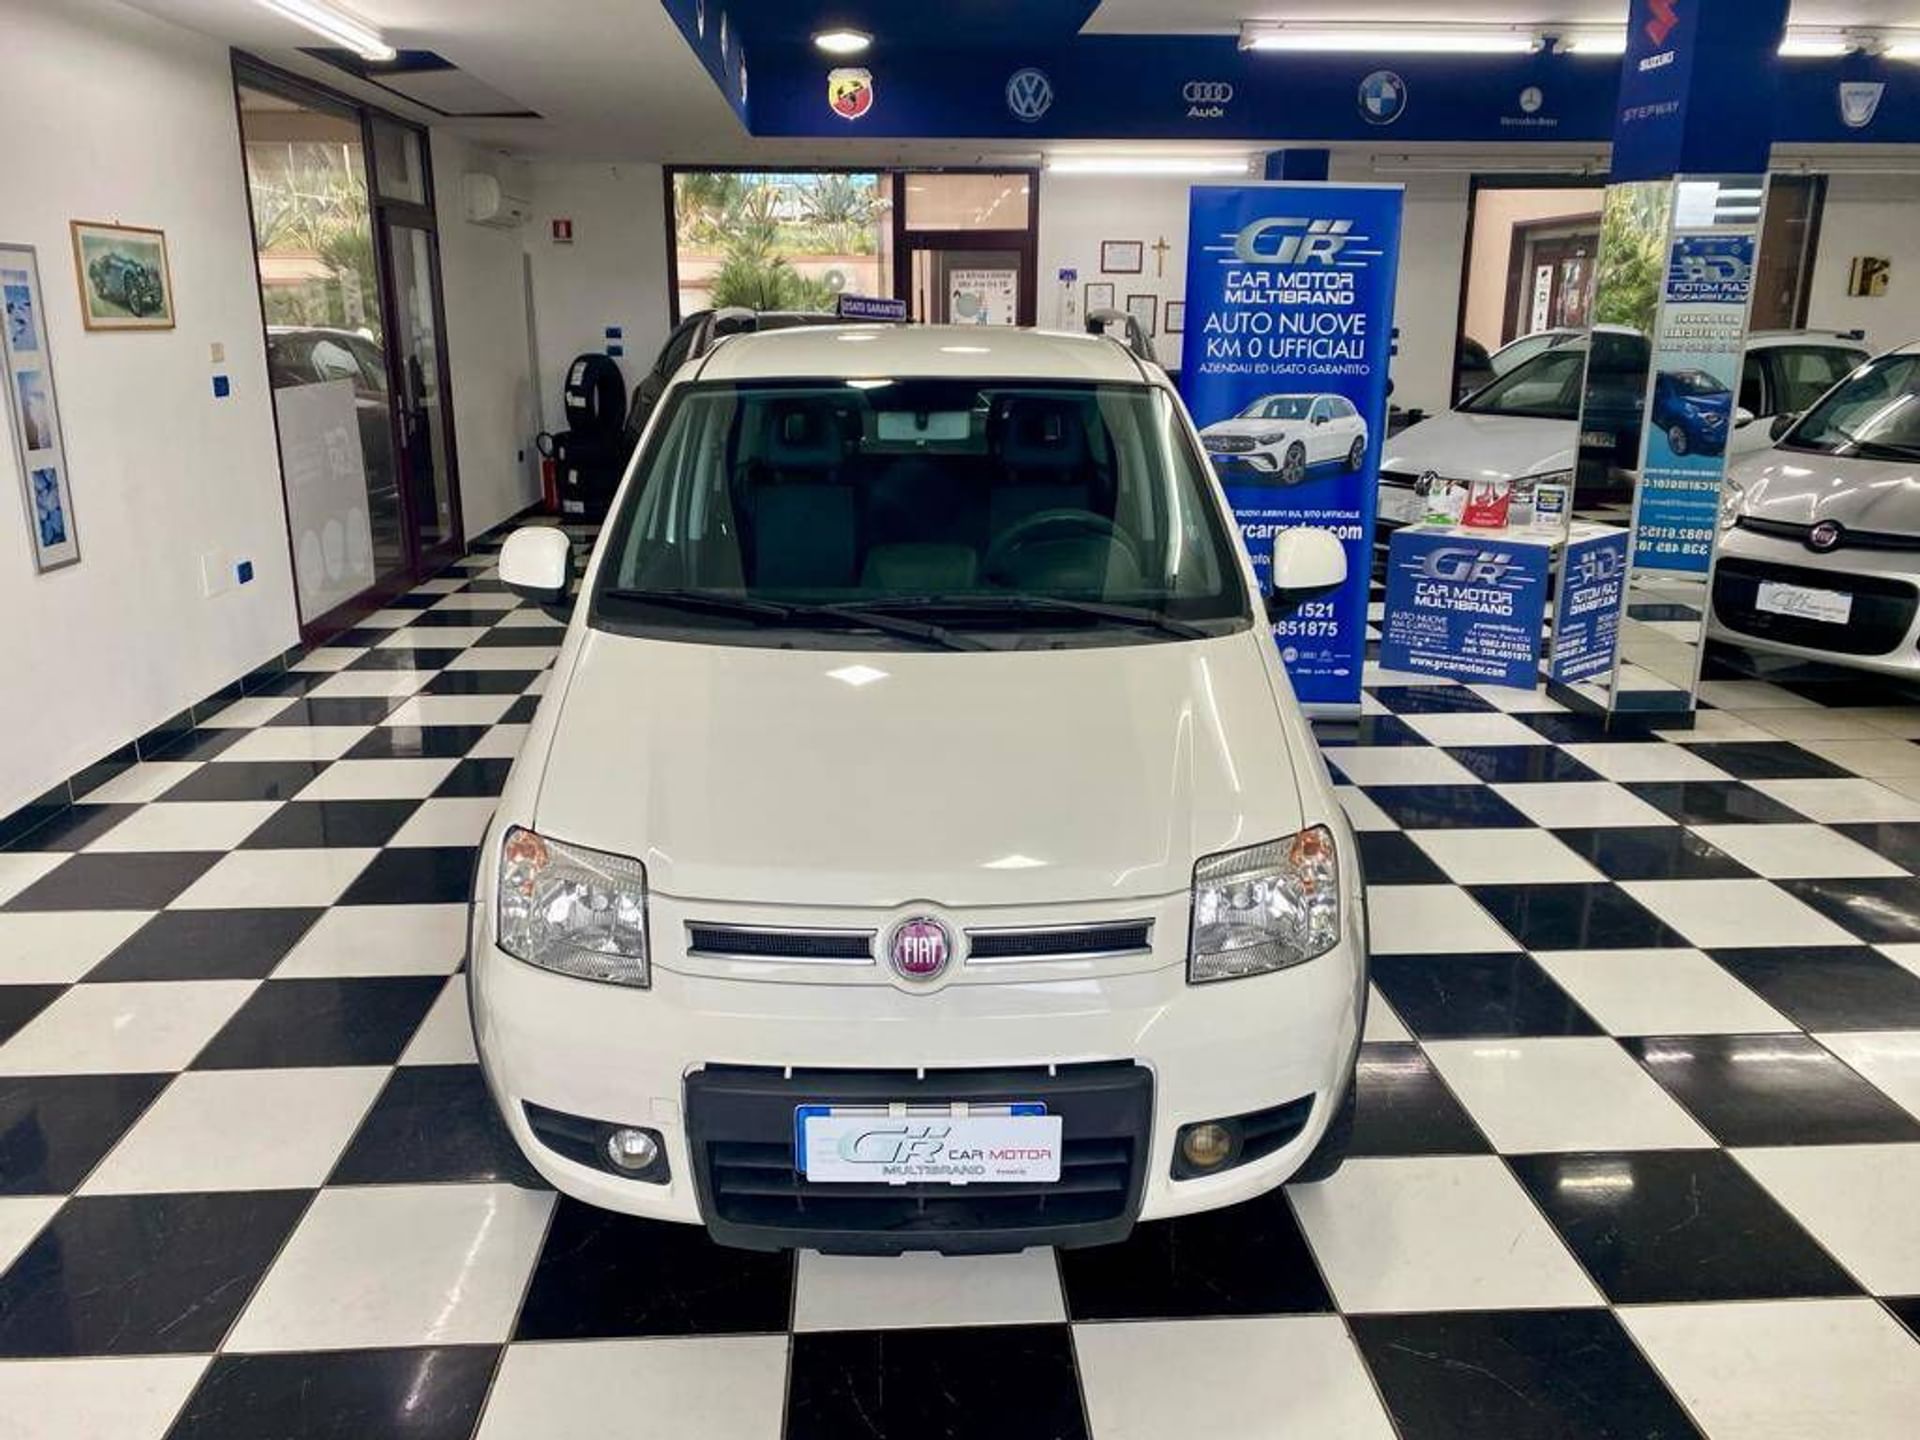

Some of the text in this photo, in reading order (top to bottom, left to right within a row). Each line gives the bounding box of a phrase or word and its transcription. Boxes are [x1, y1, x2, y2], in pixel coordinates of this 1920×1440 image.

[1187, 105, 1224, 118] Audi
[1623, 101, 1679, 122] STEPWAY
[1227, 271, 1354, 290] CAR MOTOR
[1224, 289, 1355, 305] MULTIBRAND
[1203, 312, 1366, 335] AUTO NUOVE
[1207, 338, 1365, 360] KM 0 UFFICIALI
[1199, 364, 1370, 376] AZIENDALI ED USATO GARANTITO
[1416, 583, 1513, 605] CAR MOTOR
[1414, 595, 1513, 617] MULTIBRAND
[904, 936, 937, 964] FIAT
[948, 1149, 1052, 1161] CAR MOTOR
[882, 1165, 986, 1176] MULTIBRAND
